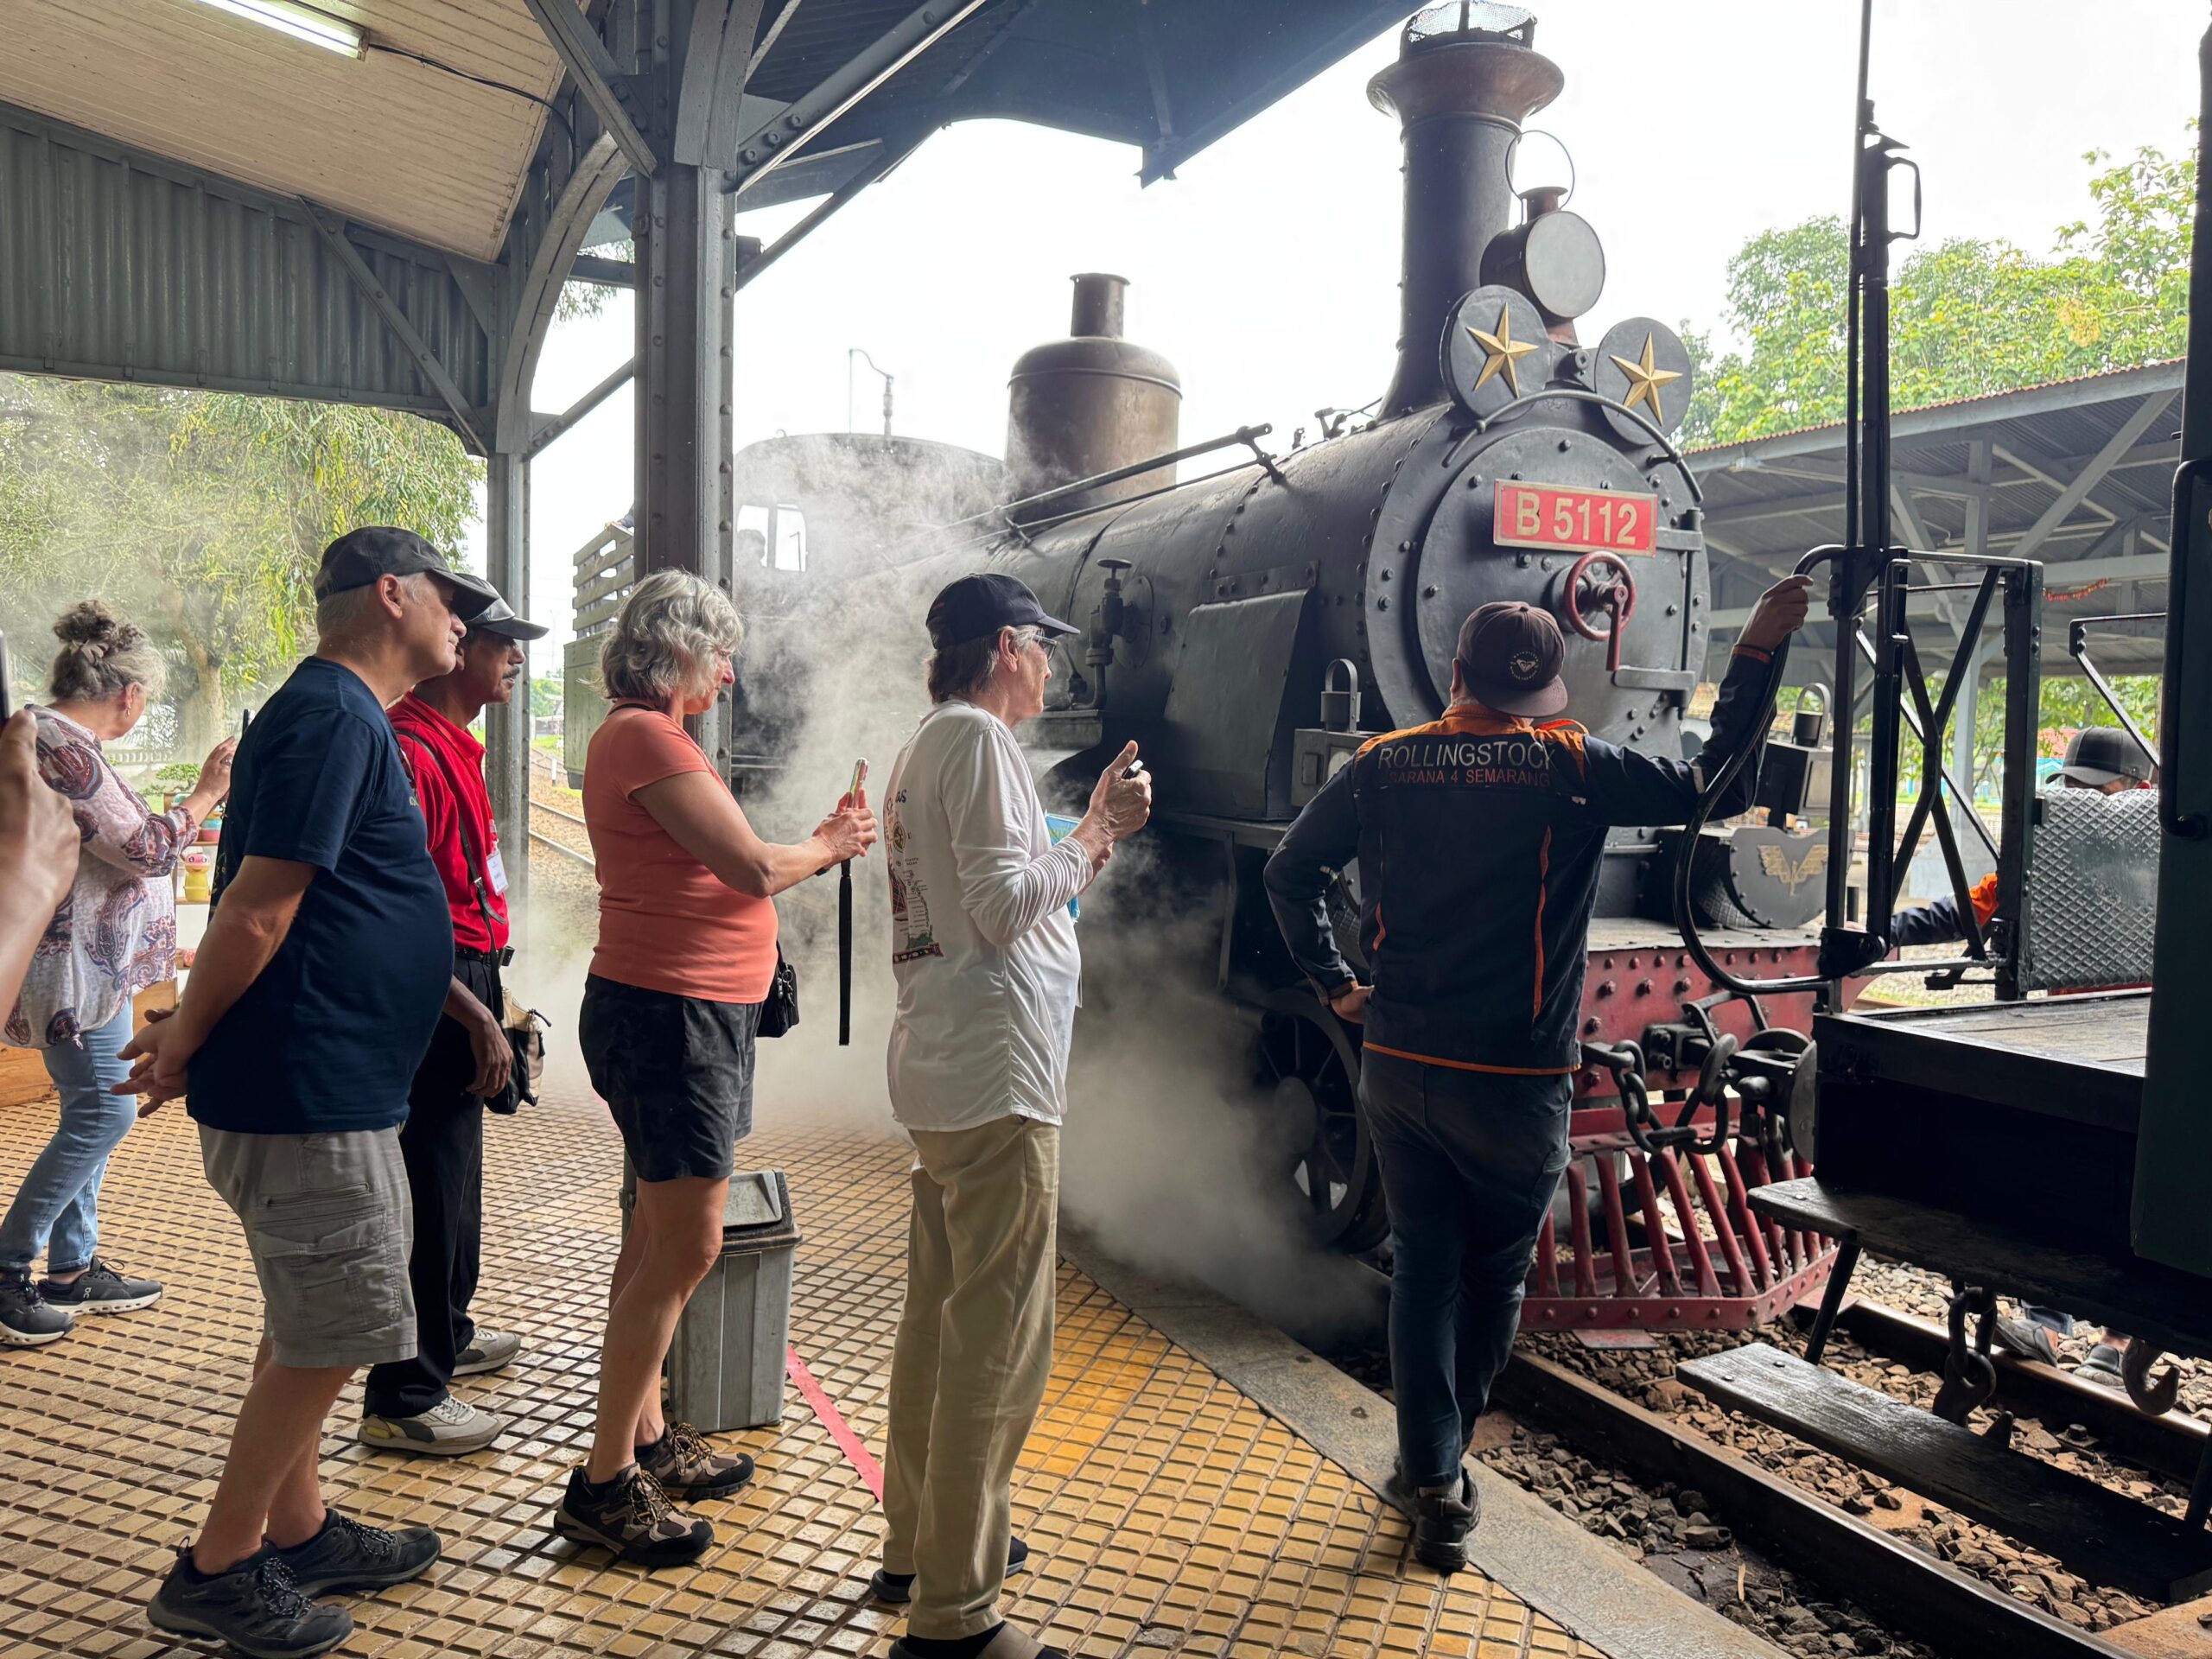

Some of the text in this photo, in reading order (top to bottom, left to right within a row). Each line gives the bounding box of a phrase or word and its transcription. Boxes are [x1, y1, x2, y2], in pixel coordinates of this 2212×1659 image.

[1516, 491, 1637, 545] B 5112
[1378, 741, 1554, 771] ROLLINGSTOCK
[1389, 768, 1550, 787] SARANA 4 SEMARANG
